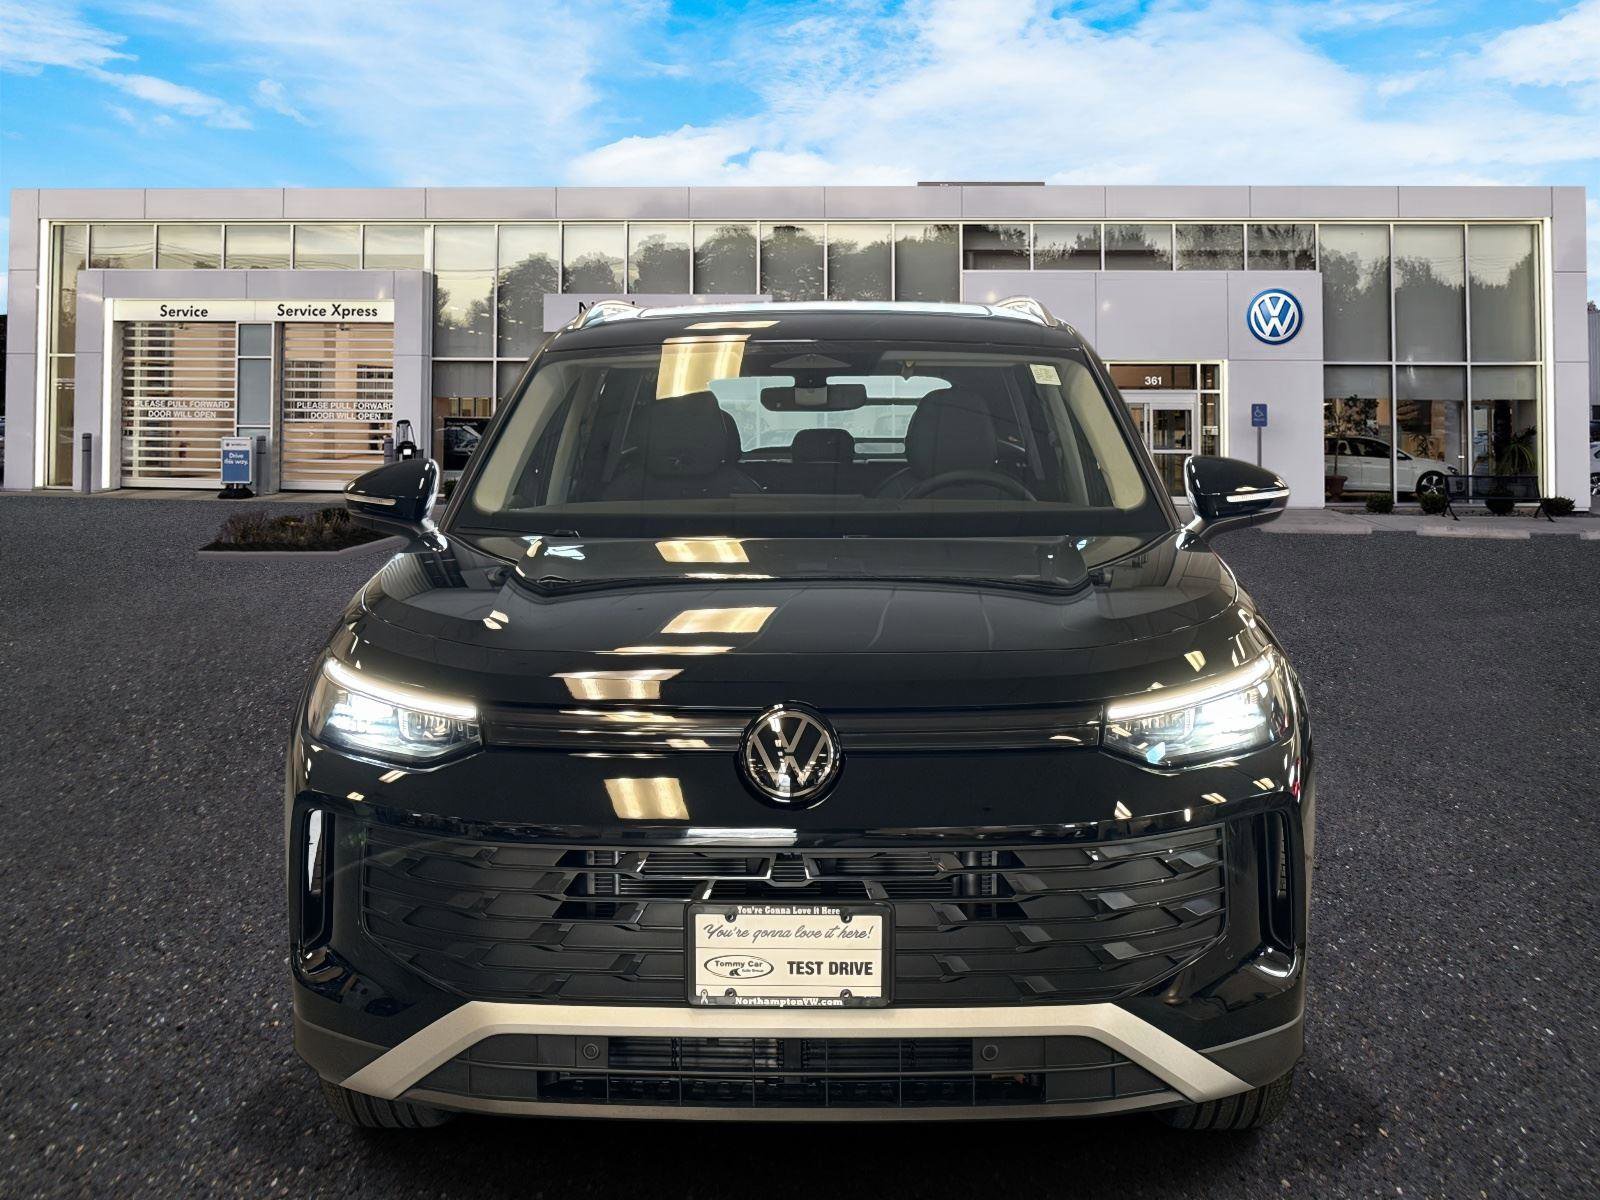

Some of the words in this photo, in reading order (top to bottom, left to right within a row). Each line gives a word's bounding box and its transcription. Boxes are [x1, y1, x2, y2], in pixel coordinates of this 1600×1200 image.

[160, 305, 208, 317] Service
[277, 304, 326, 317] Service
[331, 304, 378, 319] Xpress
[1145, 376, 1162, 385] 361
[190, 401, 230, 409] FORWARD
[297, 401, 328, 409] PLEASE
[148, 410, 171, 418] DOOR
[194, 410, 217, 418] OPEN
[336, 412, 356, 420] WILL
[357, 412, 381, 420] OPEN
[737, 906, 763, 914] You're
[764, 906, 791, 914] Gonna
[792, 906, 812, 915] Love
[821, 906, 841, 915] Here
[703, 924, 749, 940] You're
[752, 929, 792, 944] gonna
[794, 925, 822, 938] love
[824, 926, 839, 938] it
[839, 925, 874, 939] here!
[715, 960, 746, 969] Tommy
[747, 960, 764, 968] Car
[787, 961, 824, 975] TEST
[829, 961, 873, 975] DRIVE
[735, 997, 843, 1008] NorthamptonVW.com
